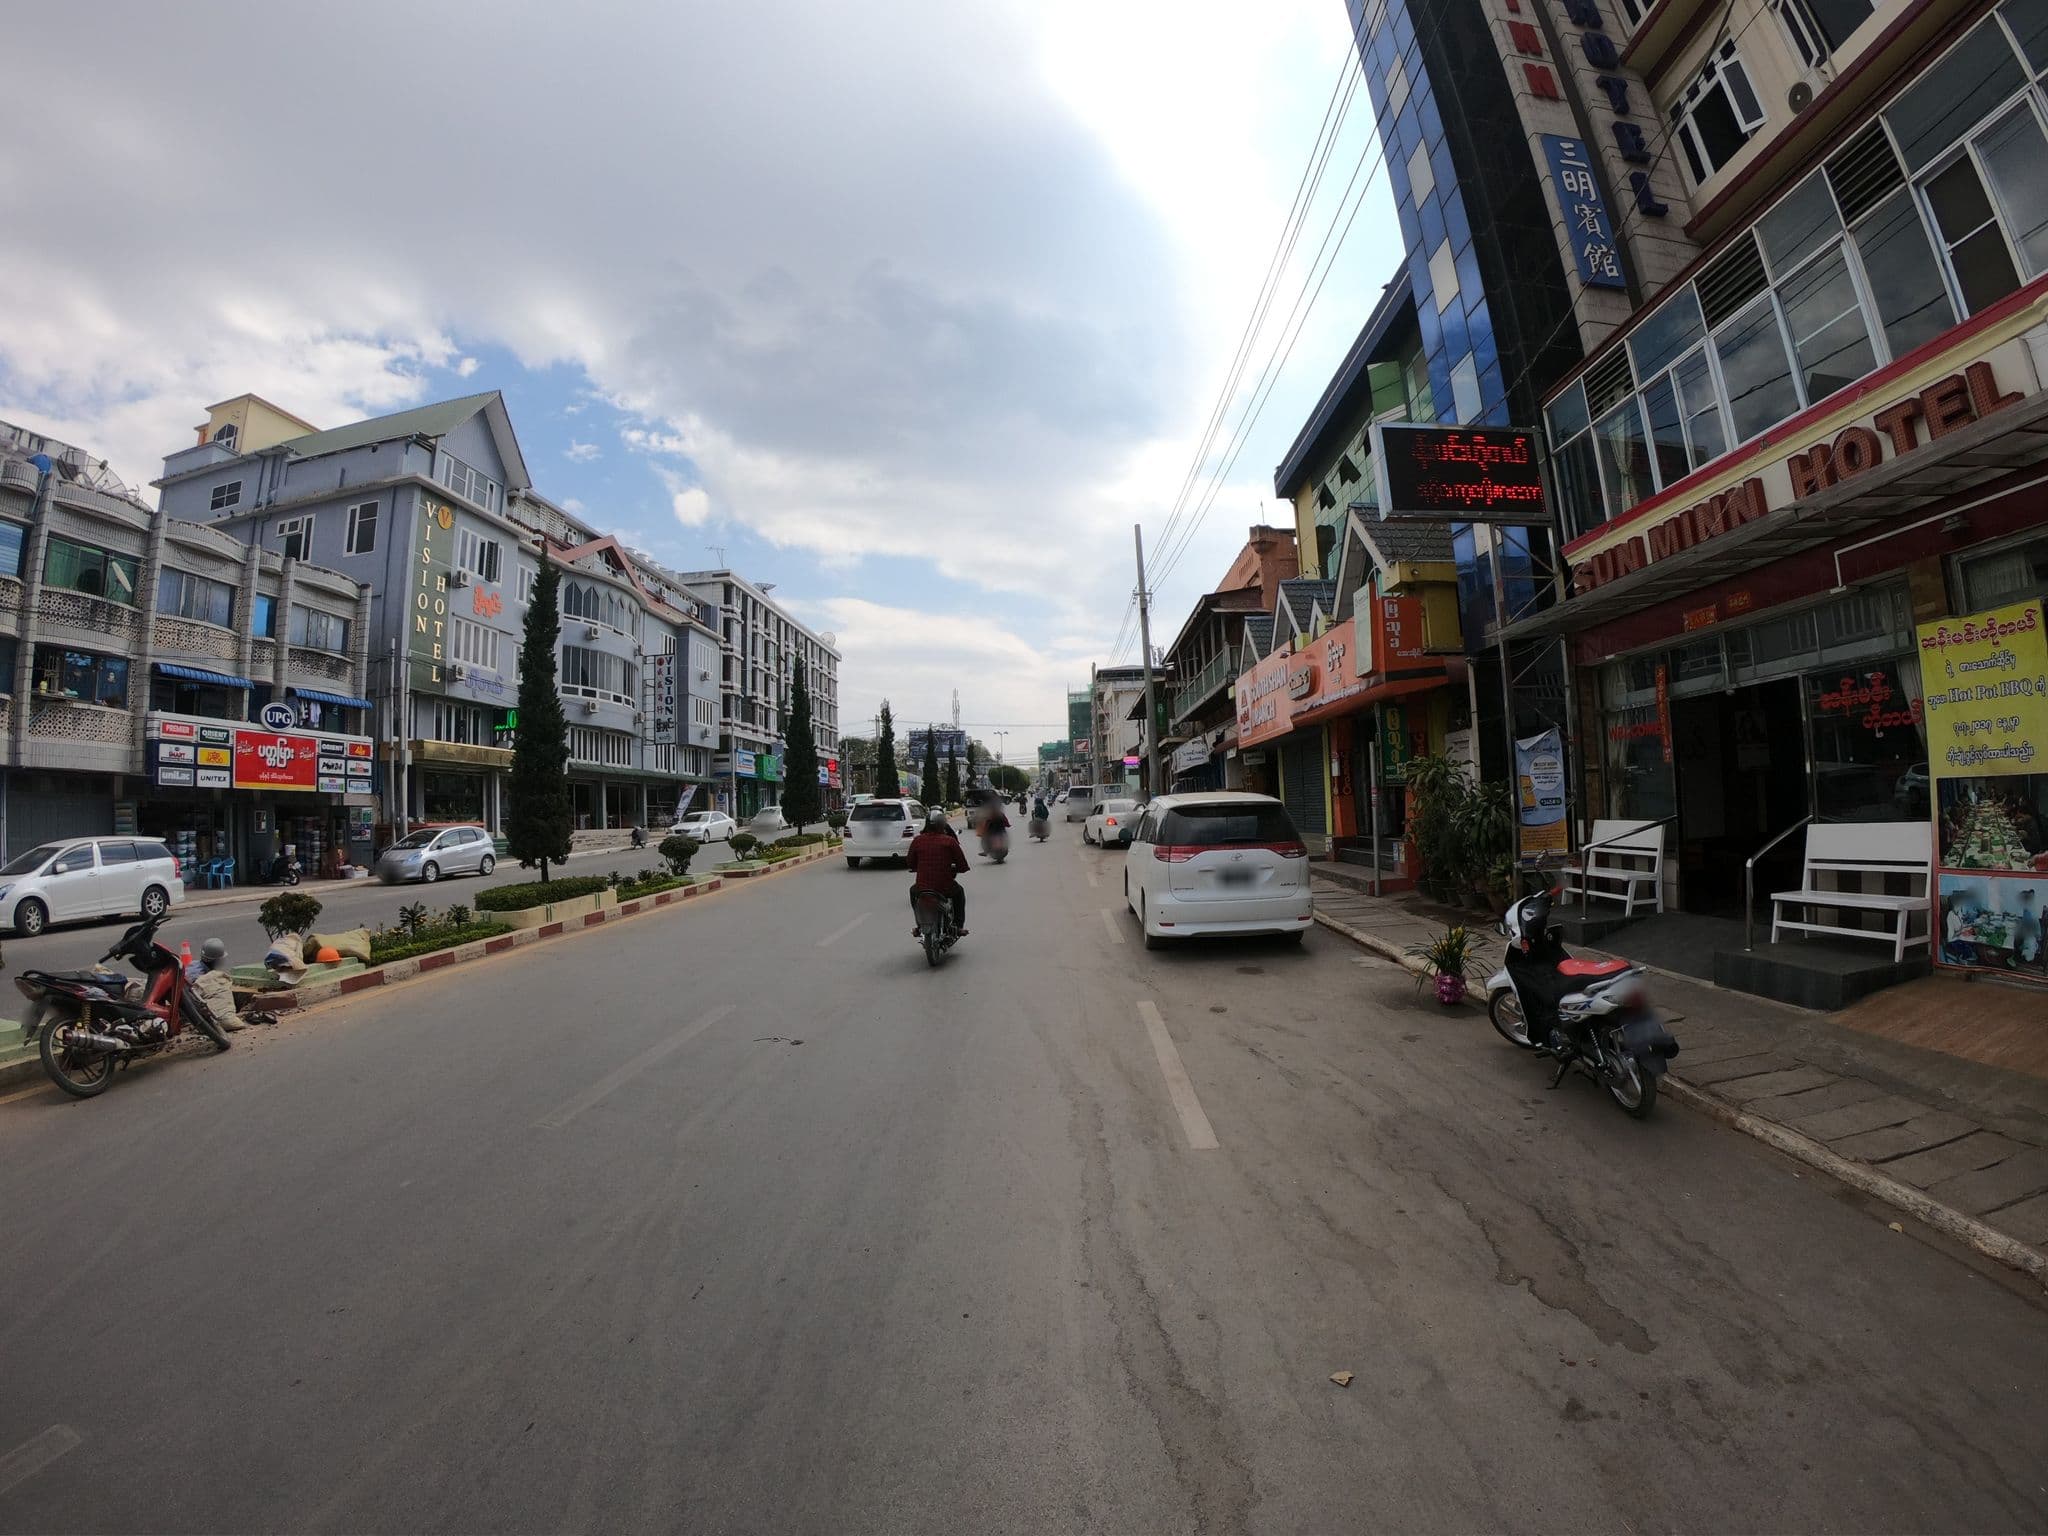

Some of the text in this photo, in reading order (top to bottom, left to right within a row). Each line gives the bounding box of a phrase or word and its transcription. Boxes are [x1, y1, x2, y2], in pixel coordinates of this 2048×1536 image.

[1559, 142, 1620, 278] 三明賓館
[1572, 361, 2026, 598] SUN MINN HOTEL
[416, 501, 447, 683] VISION HOTEL
[266, 710, 291, 725] UPG
[665, 656, 674, 715] VISION
[1949, 686, 1973, 703] Hot
[1975, 683, 1998, 700] Pot
[2000, 677, 2033, 696] BBQ
